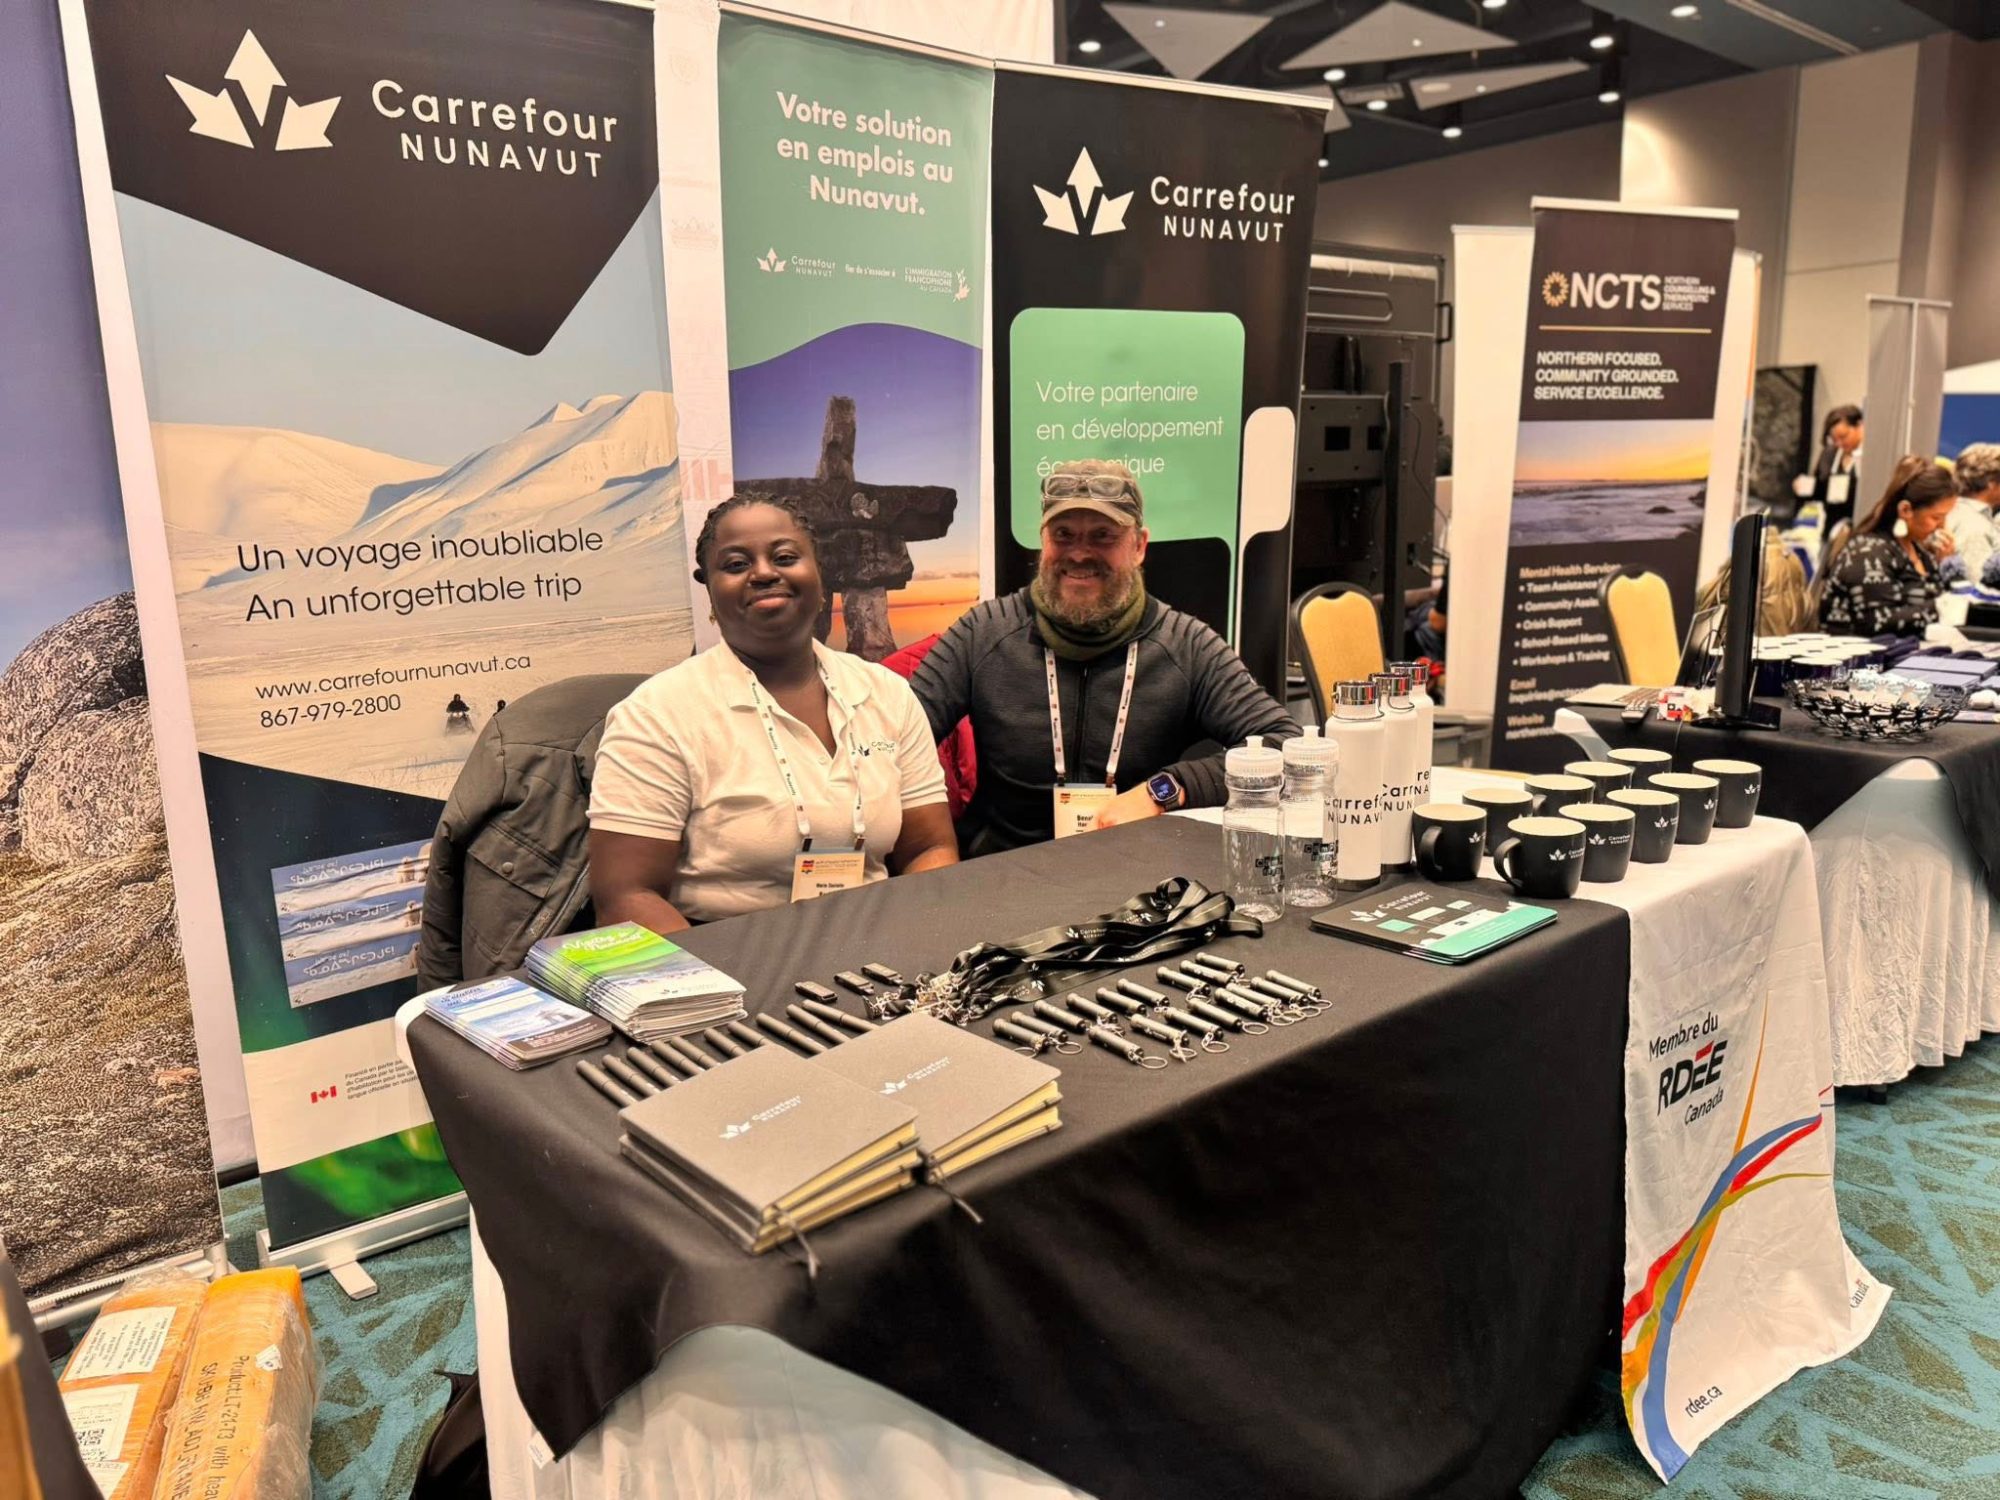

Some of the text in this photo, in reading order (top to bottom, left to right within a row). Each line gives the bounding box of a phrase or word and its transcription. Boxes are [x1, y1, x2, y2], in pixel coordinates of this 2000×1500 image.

[371, 78, 619, 144] Carrefour
[776, 91, 952, 147] Votre solution
[400, 132, 603, 178] NUNAVUT
[776, 137, 953, 183] en emplois au
[810, 174, 926, 215] Nunavut.
[1150, 175, 1296, 215] Carrefour
[1163, 214, 1284, 243] NUNAVUT
[791, 255, 836, 269] Carrefour
[796, 267, 833, 278] NUNAVUT
[905, 275, 952, 287] FRANCOPHONE
[1569, 271, 1662, 311] NCTS
[1535, 368, 1679, 383] COMMUNITY GROUNDED.
[1536, 351, 1662, 366] NORTHERN FOCUSED.
[1036, 381, 1198, 408] Votre partenaire
[1533, 386, 1664, 400] SERVICE EXCELLENCE.
[1036, 416, 1224, 442] en développement
[1036, 454, 1165, 479] écique
[237, 527, 604, 574] Un voyage inoubliable
[245, 572, 583, 622] An unforgettable trip
[255, 653, 532, 700] www.carrefournunavut.ca
[260, 693, 402, 729] 867-979-2800
[1327, 811, 1383, 825] NUNAV
[1649, 1011, 1718, 1062] Membre du
[1684, 1086, 1724, 1125] Canada
[1684, 1385, 1724, 1418] rdee.ca
